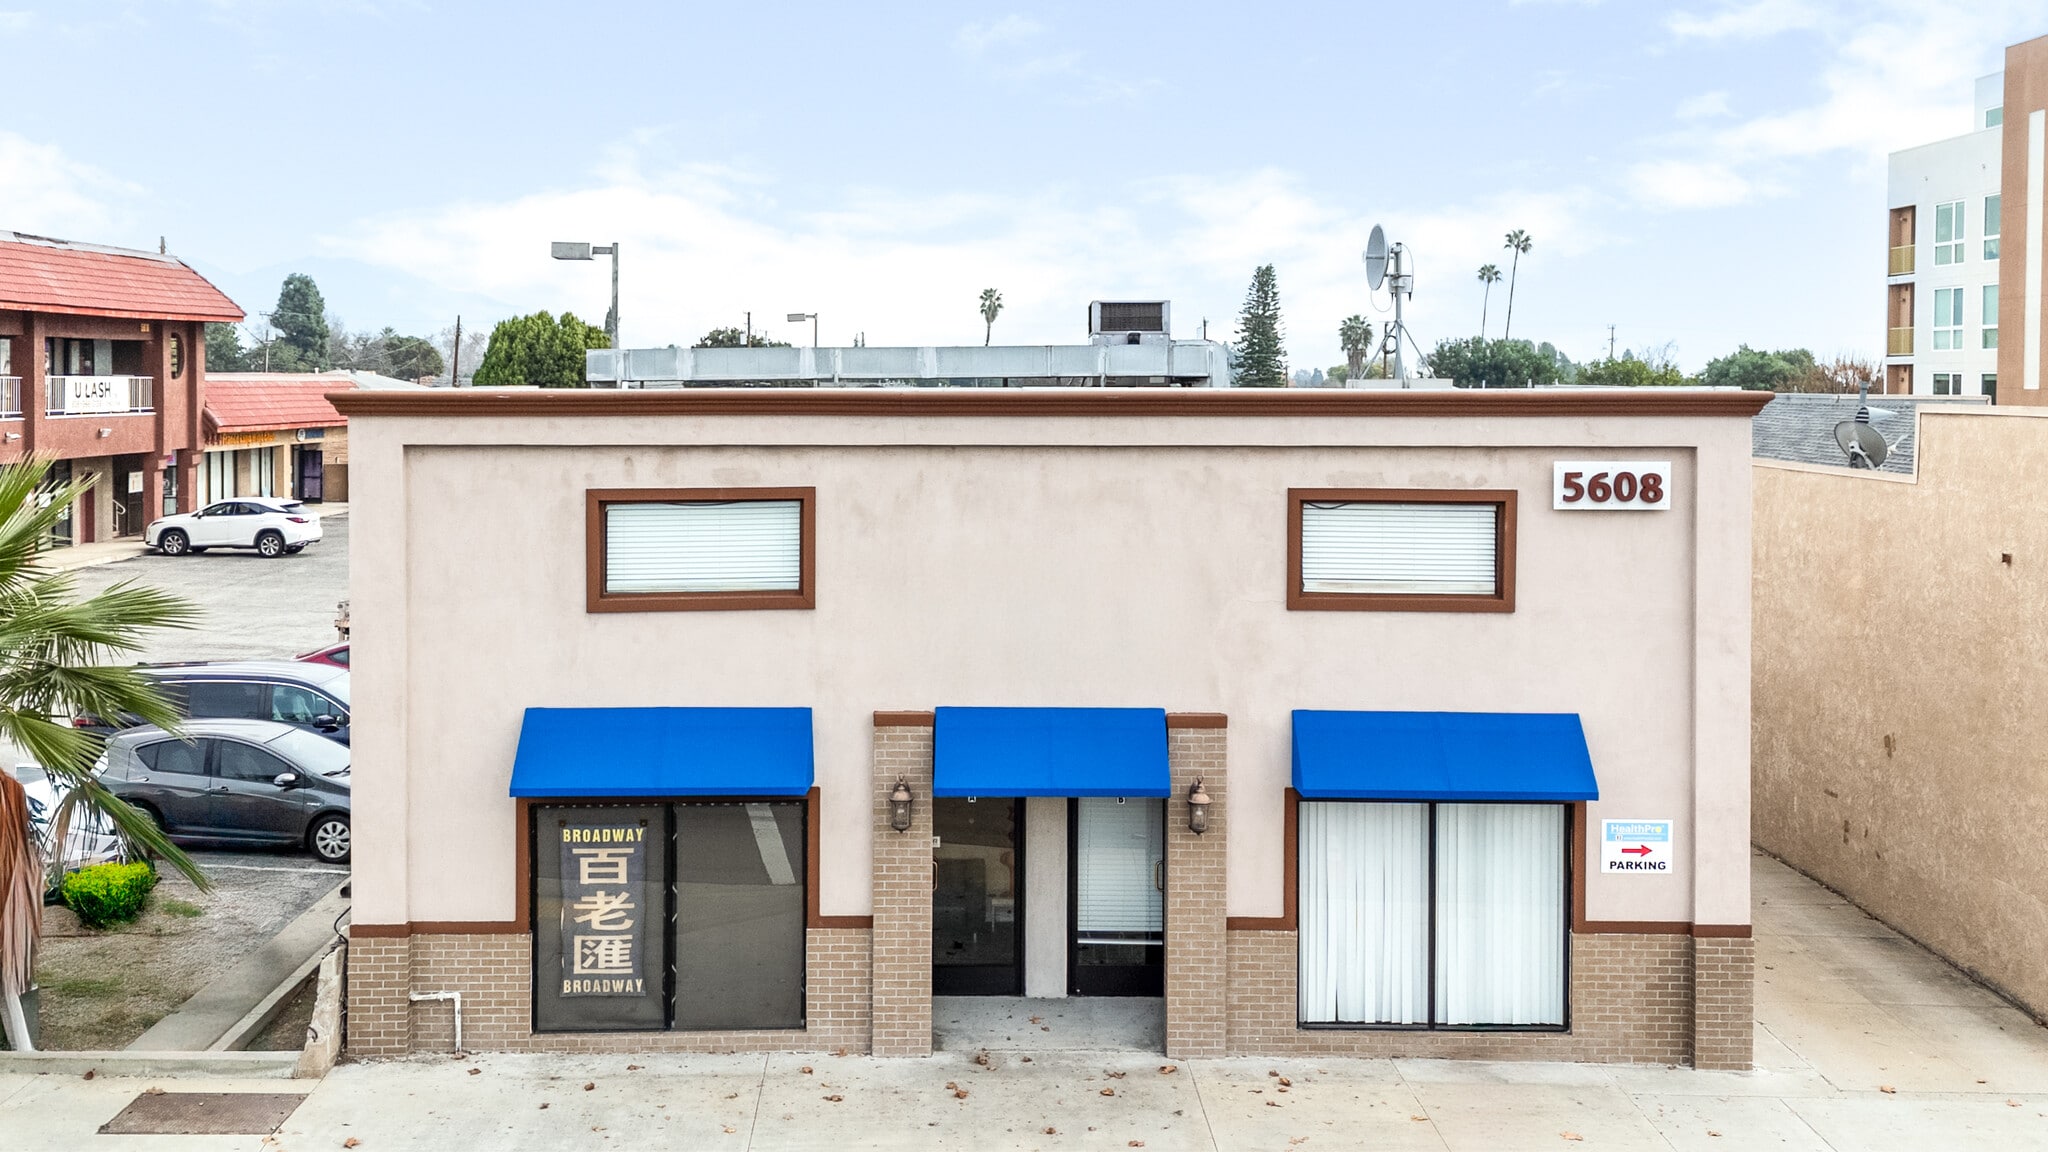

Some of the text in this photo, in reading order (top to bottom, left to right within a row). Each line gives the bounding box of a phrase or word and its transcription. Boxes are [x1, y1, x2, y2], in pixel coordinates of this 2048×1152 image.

[74, 382, 111, 399] U LASH
[1562, 471, 1664, 503] 5608
[563, 828, 644, 843] BROADWAY
[1609, 861, 1667, 870] PARKING
[572, 847, 635, 975] 百老匯
[563, 978, 644, 993] BROADWAY
